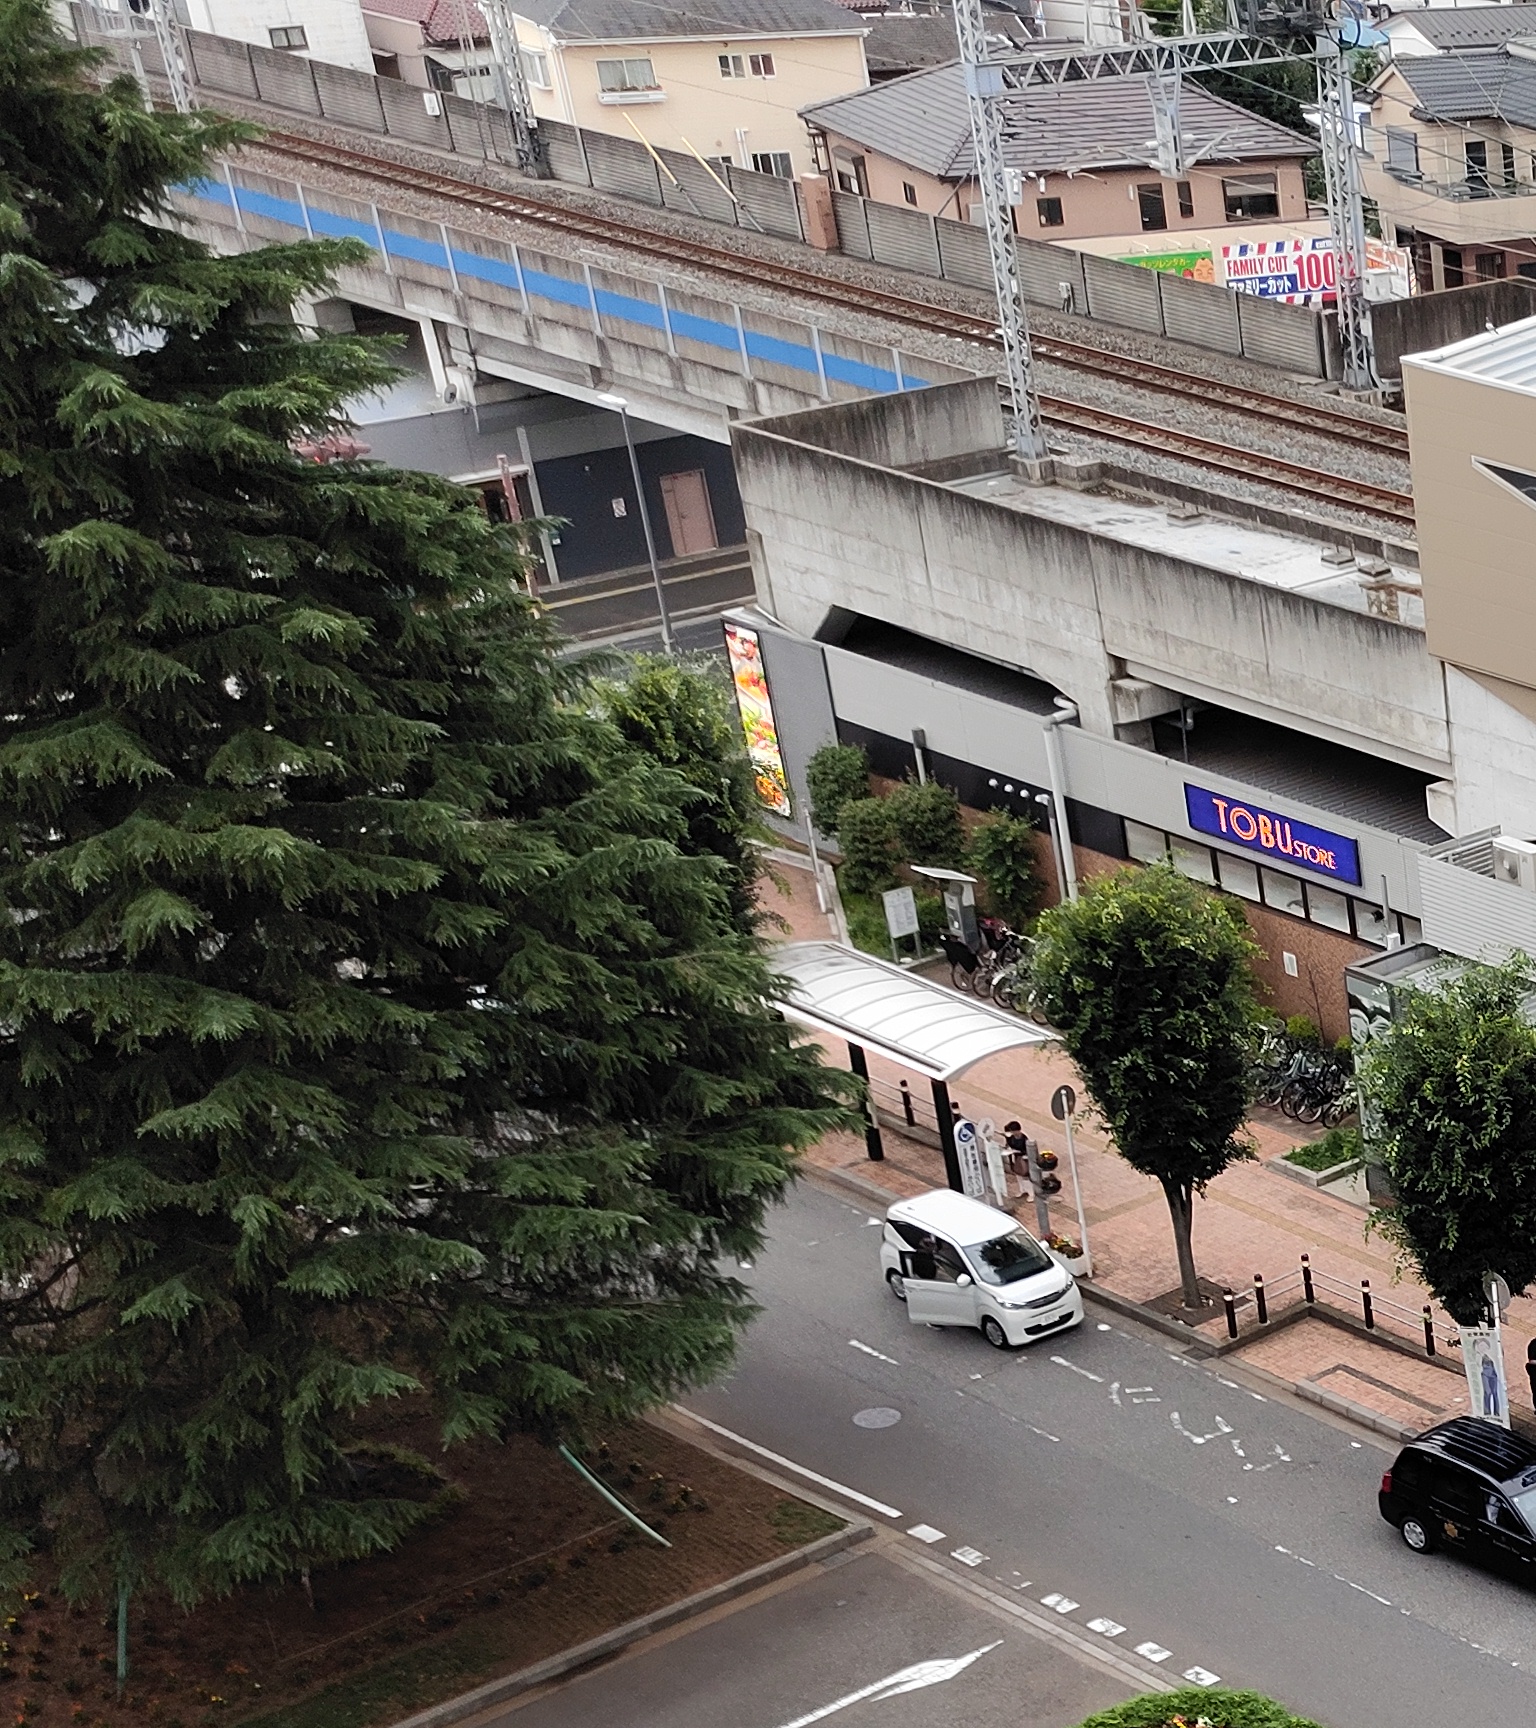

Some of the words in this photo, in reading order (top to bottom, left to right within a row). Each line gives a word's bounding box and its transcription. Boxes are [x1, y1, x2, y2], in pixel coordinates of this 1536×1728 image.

[1227, 257, 1264, 277] FAMILY
[1267, 255, 1288, 273] CUT
[1293, 251, 1350, 290] 100
[1212, 798, 1293, 856] TOBU
[1293, 840, 1338, 870] STORE
